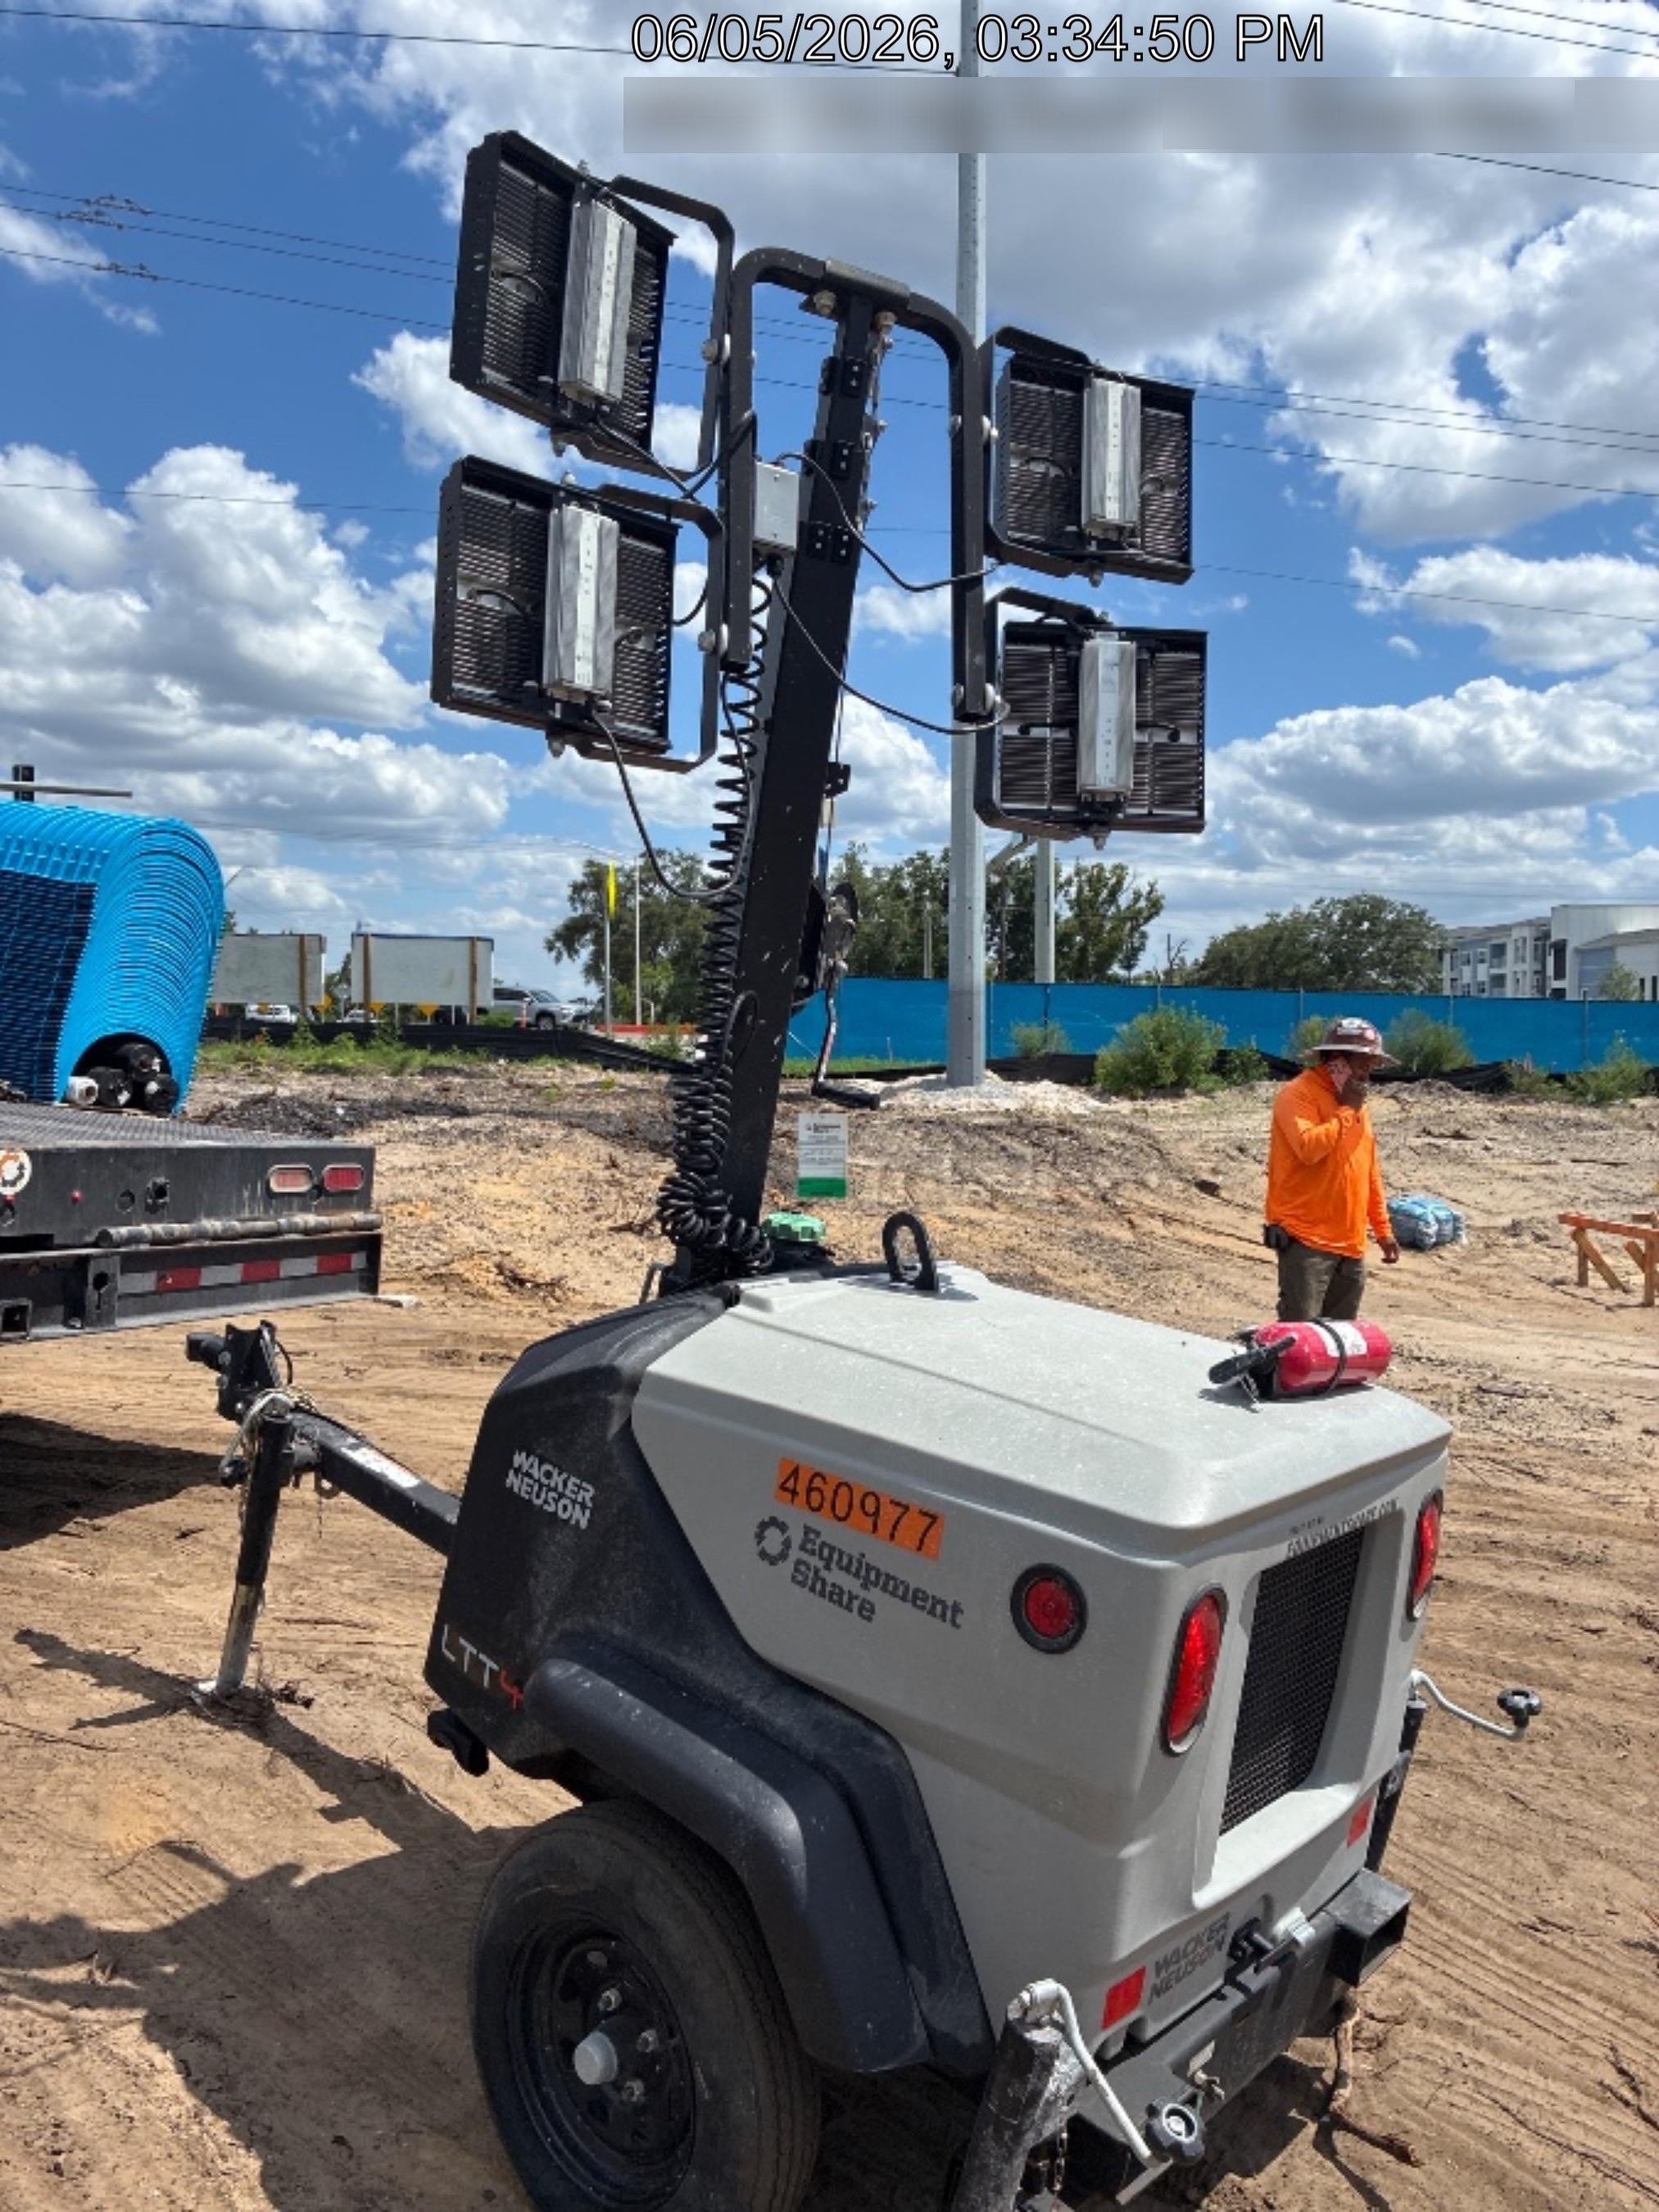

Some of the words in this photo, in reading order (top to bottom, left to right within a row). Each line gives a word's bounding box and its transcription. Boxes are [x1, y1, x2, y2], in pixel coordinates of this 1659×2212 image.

[505, 1469, 591, 1530] NEUSON
[513, 1449, 595, 1508] WACKER
[779, 1465, 939, 1552] 460977
[791, 1558, 876, 1623] Share
[799, 1523, 964, 1630] Equipment
[1147, 1931, 1227, 2006] NEUSON
[1154, 1911, 1230, 1979] WACKER
